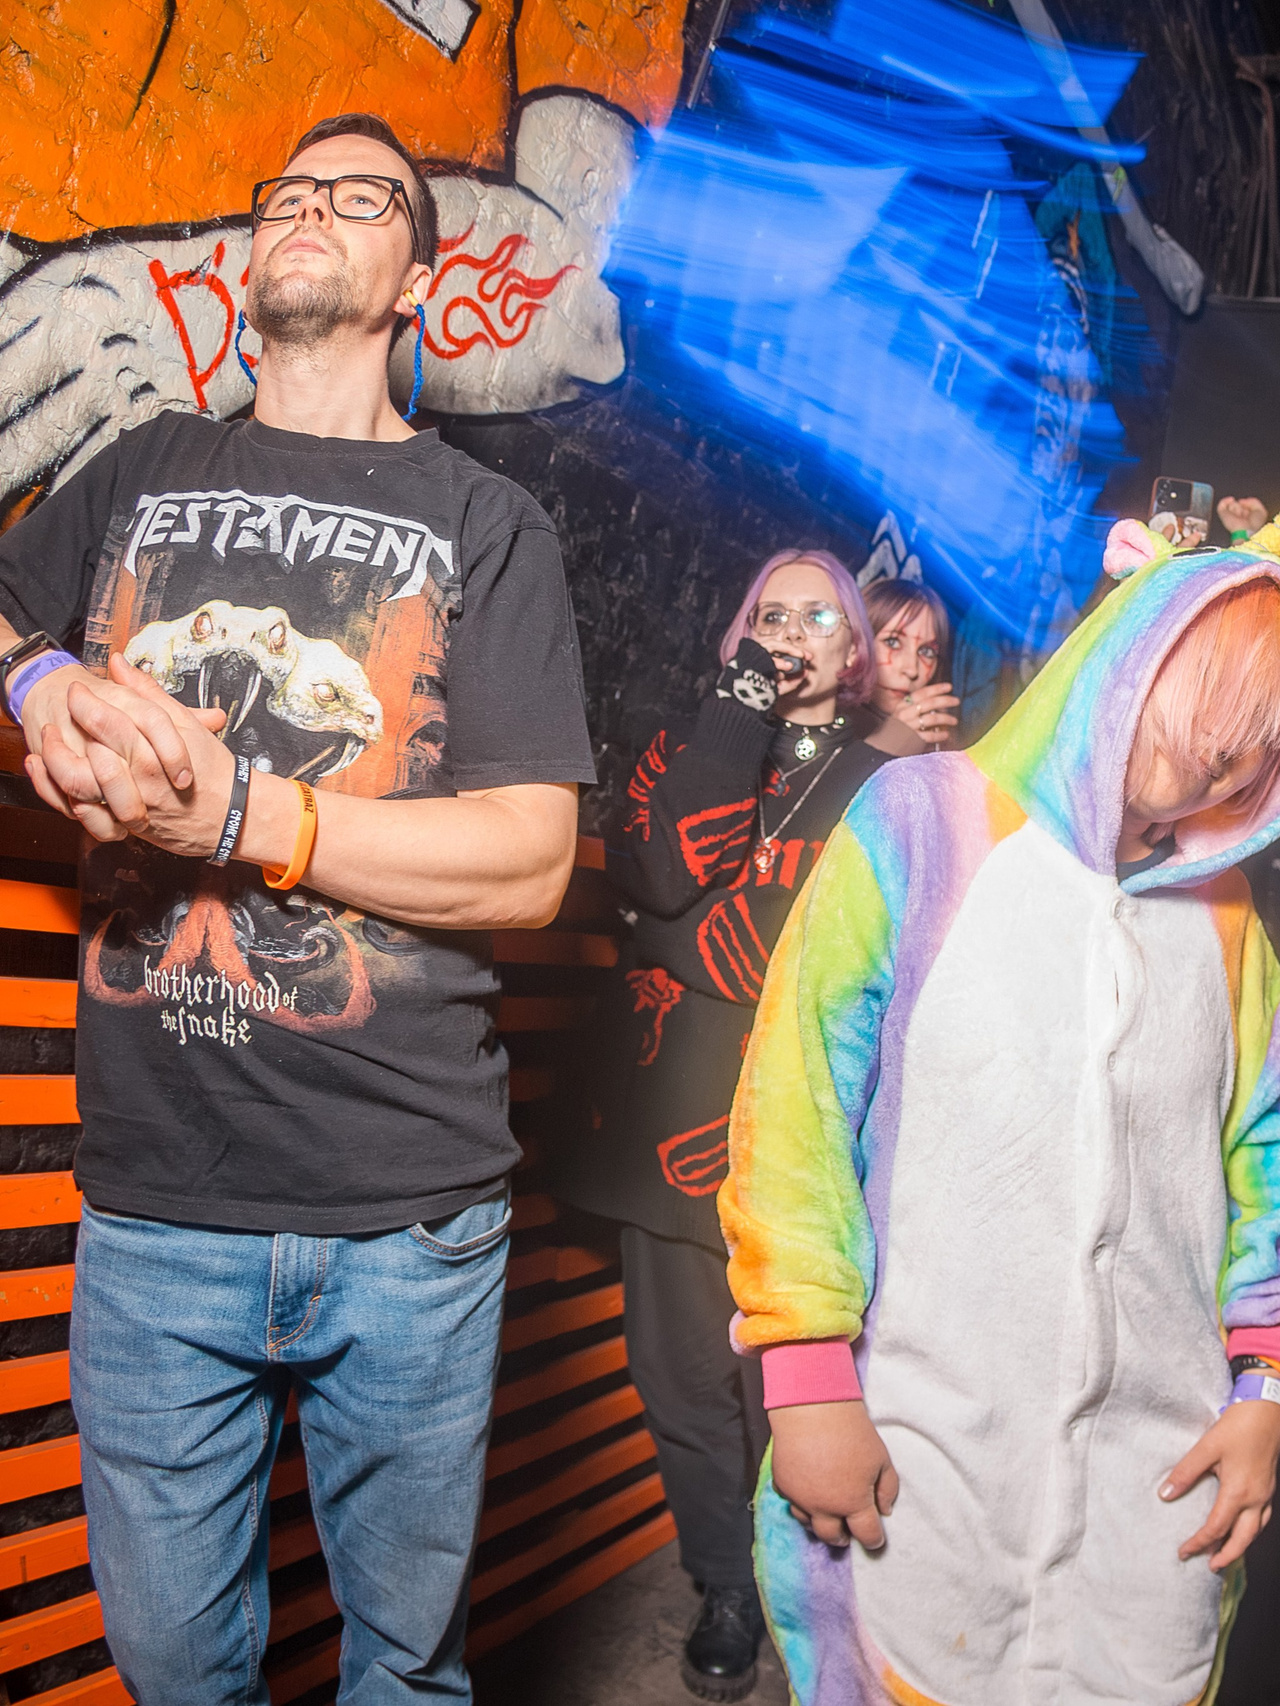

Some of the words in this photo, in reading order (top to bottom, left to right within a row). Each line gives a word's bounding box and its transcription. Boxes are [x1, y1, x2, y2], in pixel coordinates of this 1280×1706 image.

[125, 489, 455, 602] TESTAMENT
[143, 954, 281, 1015] brotherhood
[282, 985, 299, 1011] of
[160, 1009, 178, 1032] the
